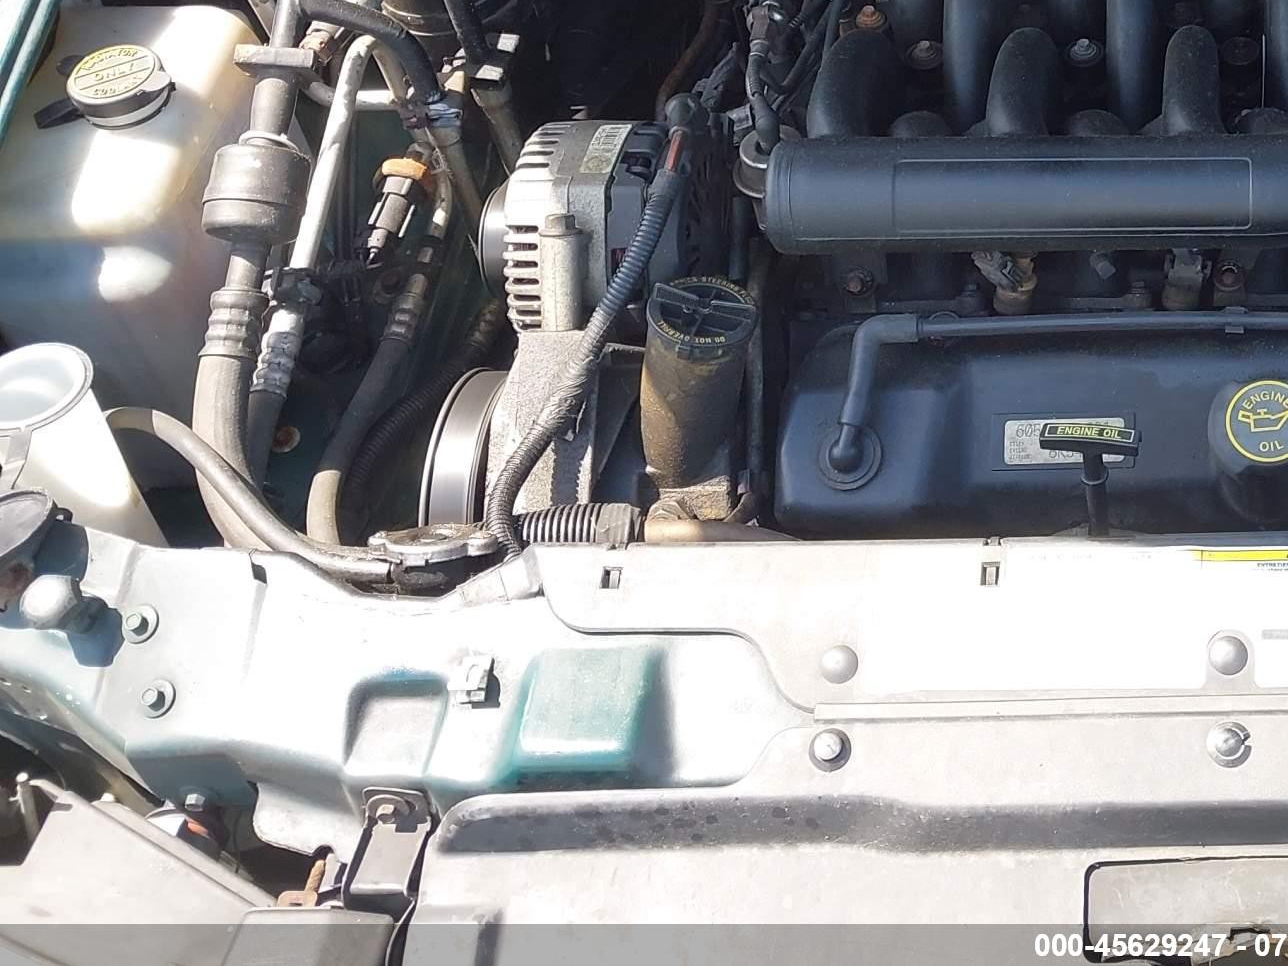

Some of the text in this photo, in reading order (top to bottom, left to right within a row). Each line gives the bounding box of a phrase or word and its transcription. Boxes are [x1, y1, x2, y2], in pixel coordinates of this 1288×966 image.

[1056, 426, 1122, 438] ENGINE OIL
[1260, 440, 1284, 452] OIL
